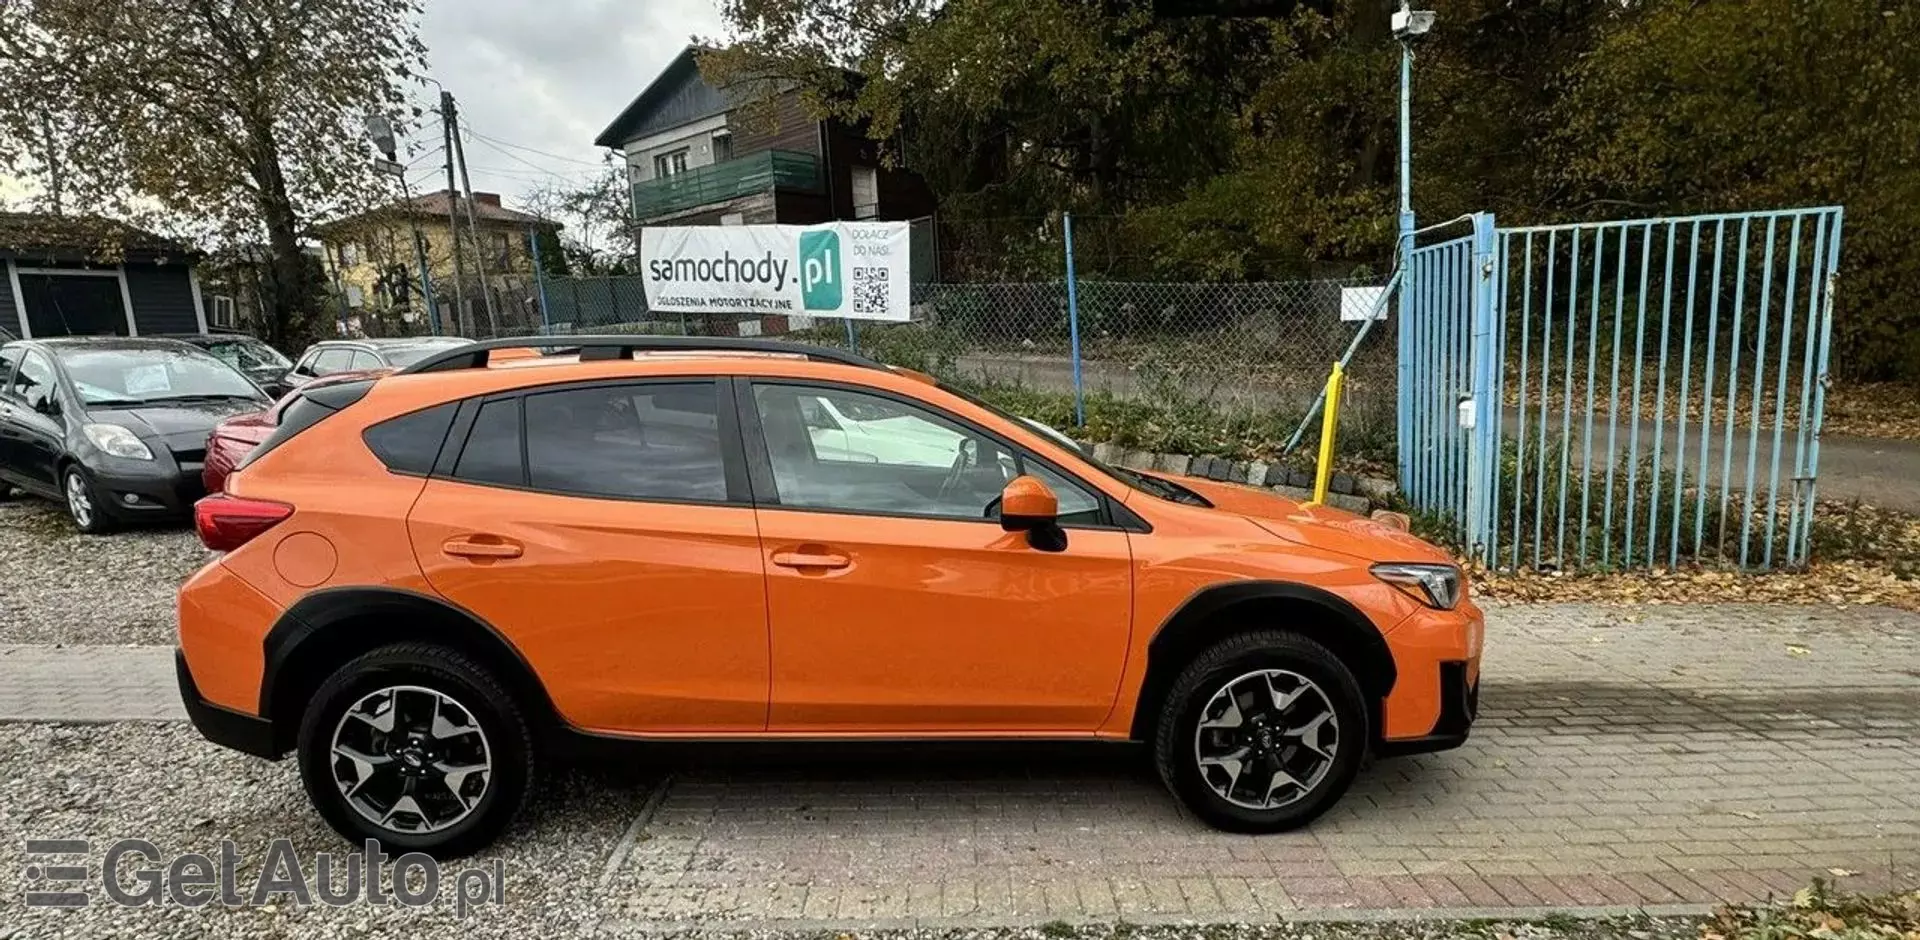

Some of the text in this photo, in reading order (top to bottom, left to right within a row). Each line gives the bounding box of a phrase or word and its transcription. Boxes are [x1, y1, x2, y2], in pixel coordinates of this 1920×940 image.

[853, 245, 867, 256] DO
[650, 250, 833, 292] samochody.pl
[709, 297, 793, 310] MOTORYZACYJNE
